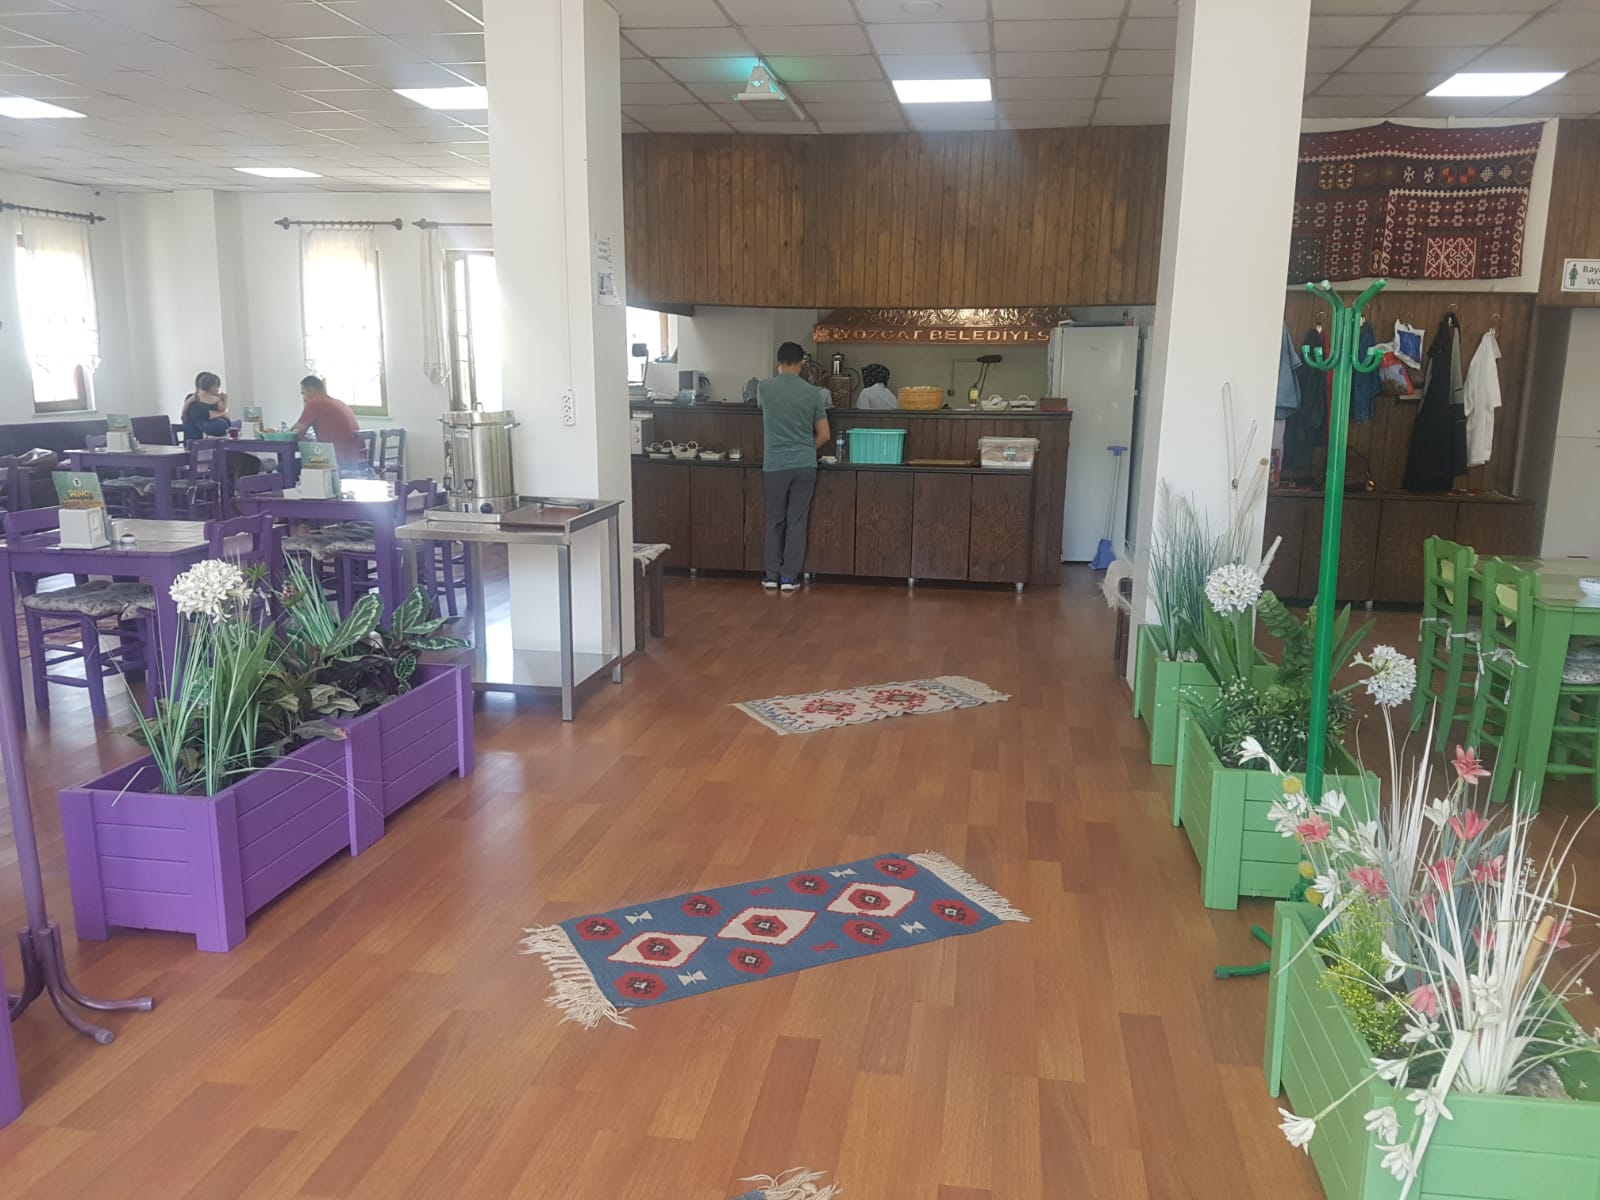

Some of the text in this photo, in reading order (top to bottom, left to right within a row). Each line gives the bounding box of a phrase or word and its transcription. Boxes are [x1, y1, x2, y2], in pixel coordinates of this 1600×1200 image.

[1583, 265, 1600, 274] Bay
[840, 328, 1050, 341] YOZGAT BELEDİYES
